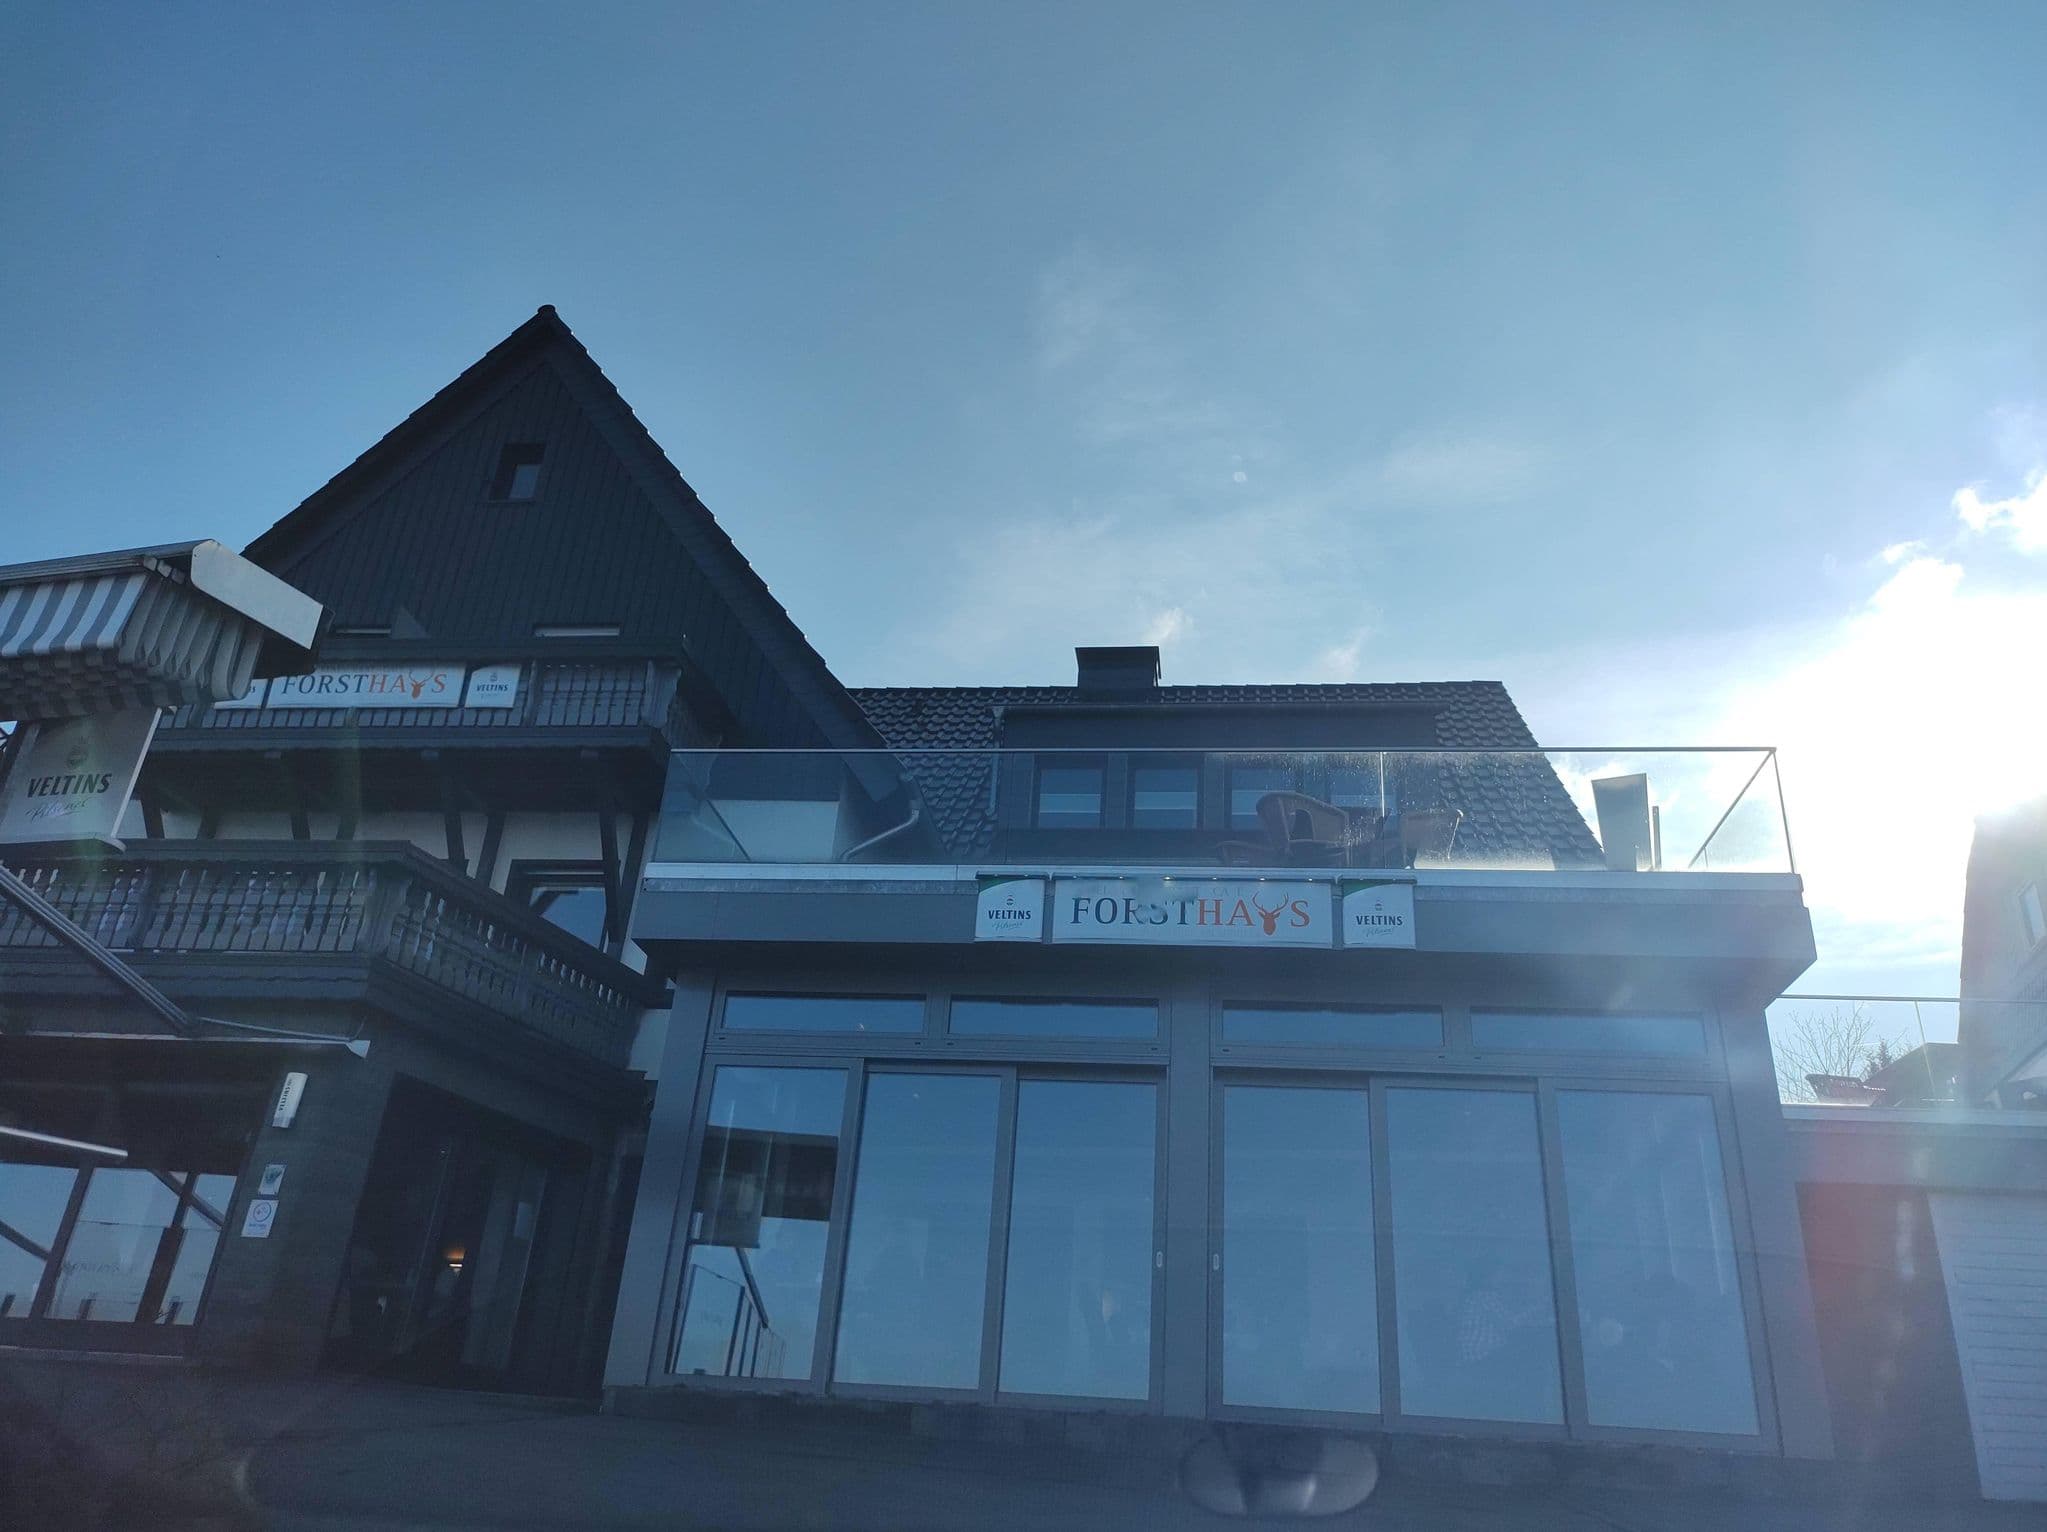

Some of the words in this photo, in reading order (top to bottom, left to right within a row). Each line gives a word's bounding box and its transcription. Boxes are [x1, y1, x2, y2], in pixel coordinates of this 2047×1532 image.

[27, 773, 112, 798] VELTINS
[988, 909, 1032, 920] VELTINS
[1356, 915, 1403, 926] VELTINS
